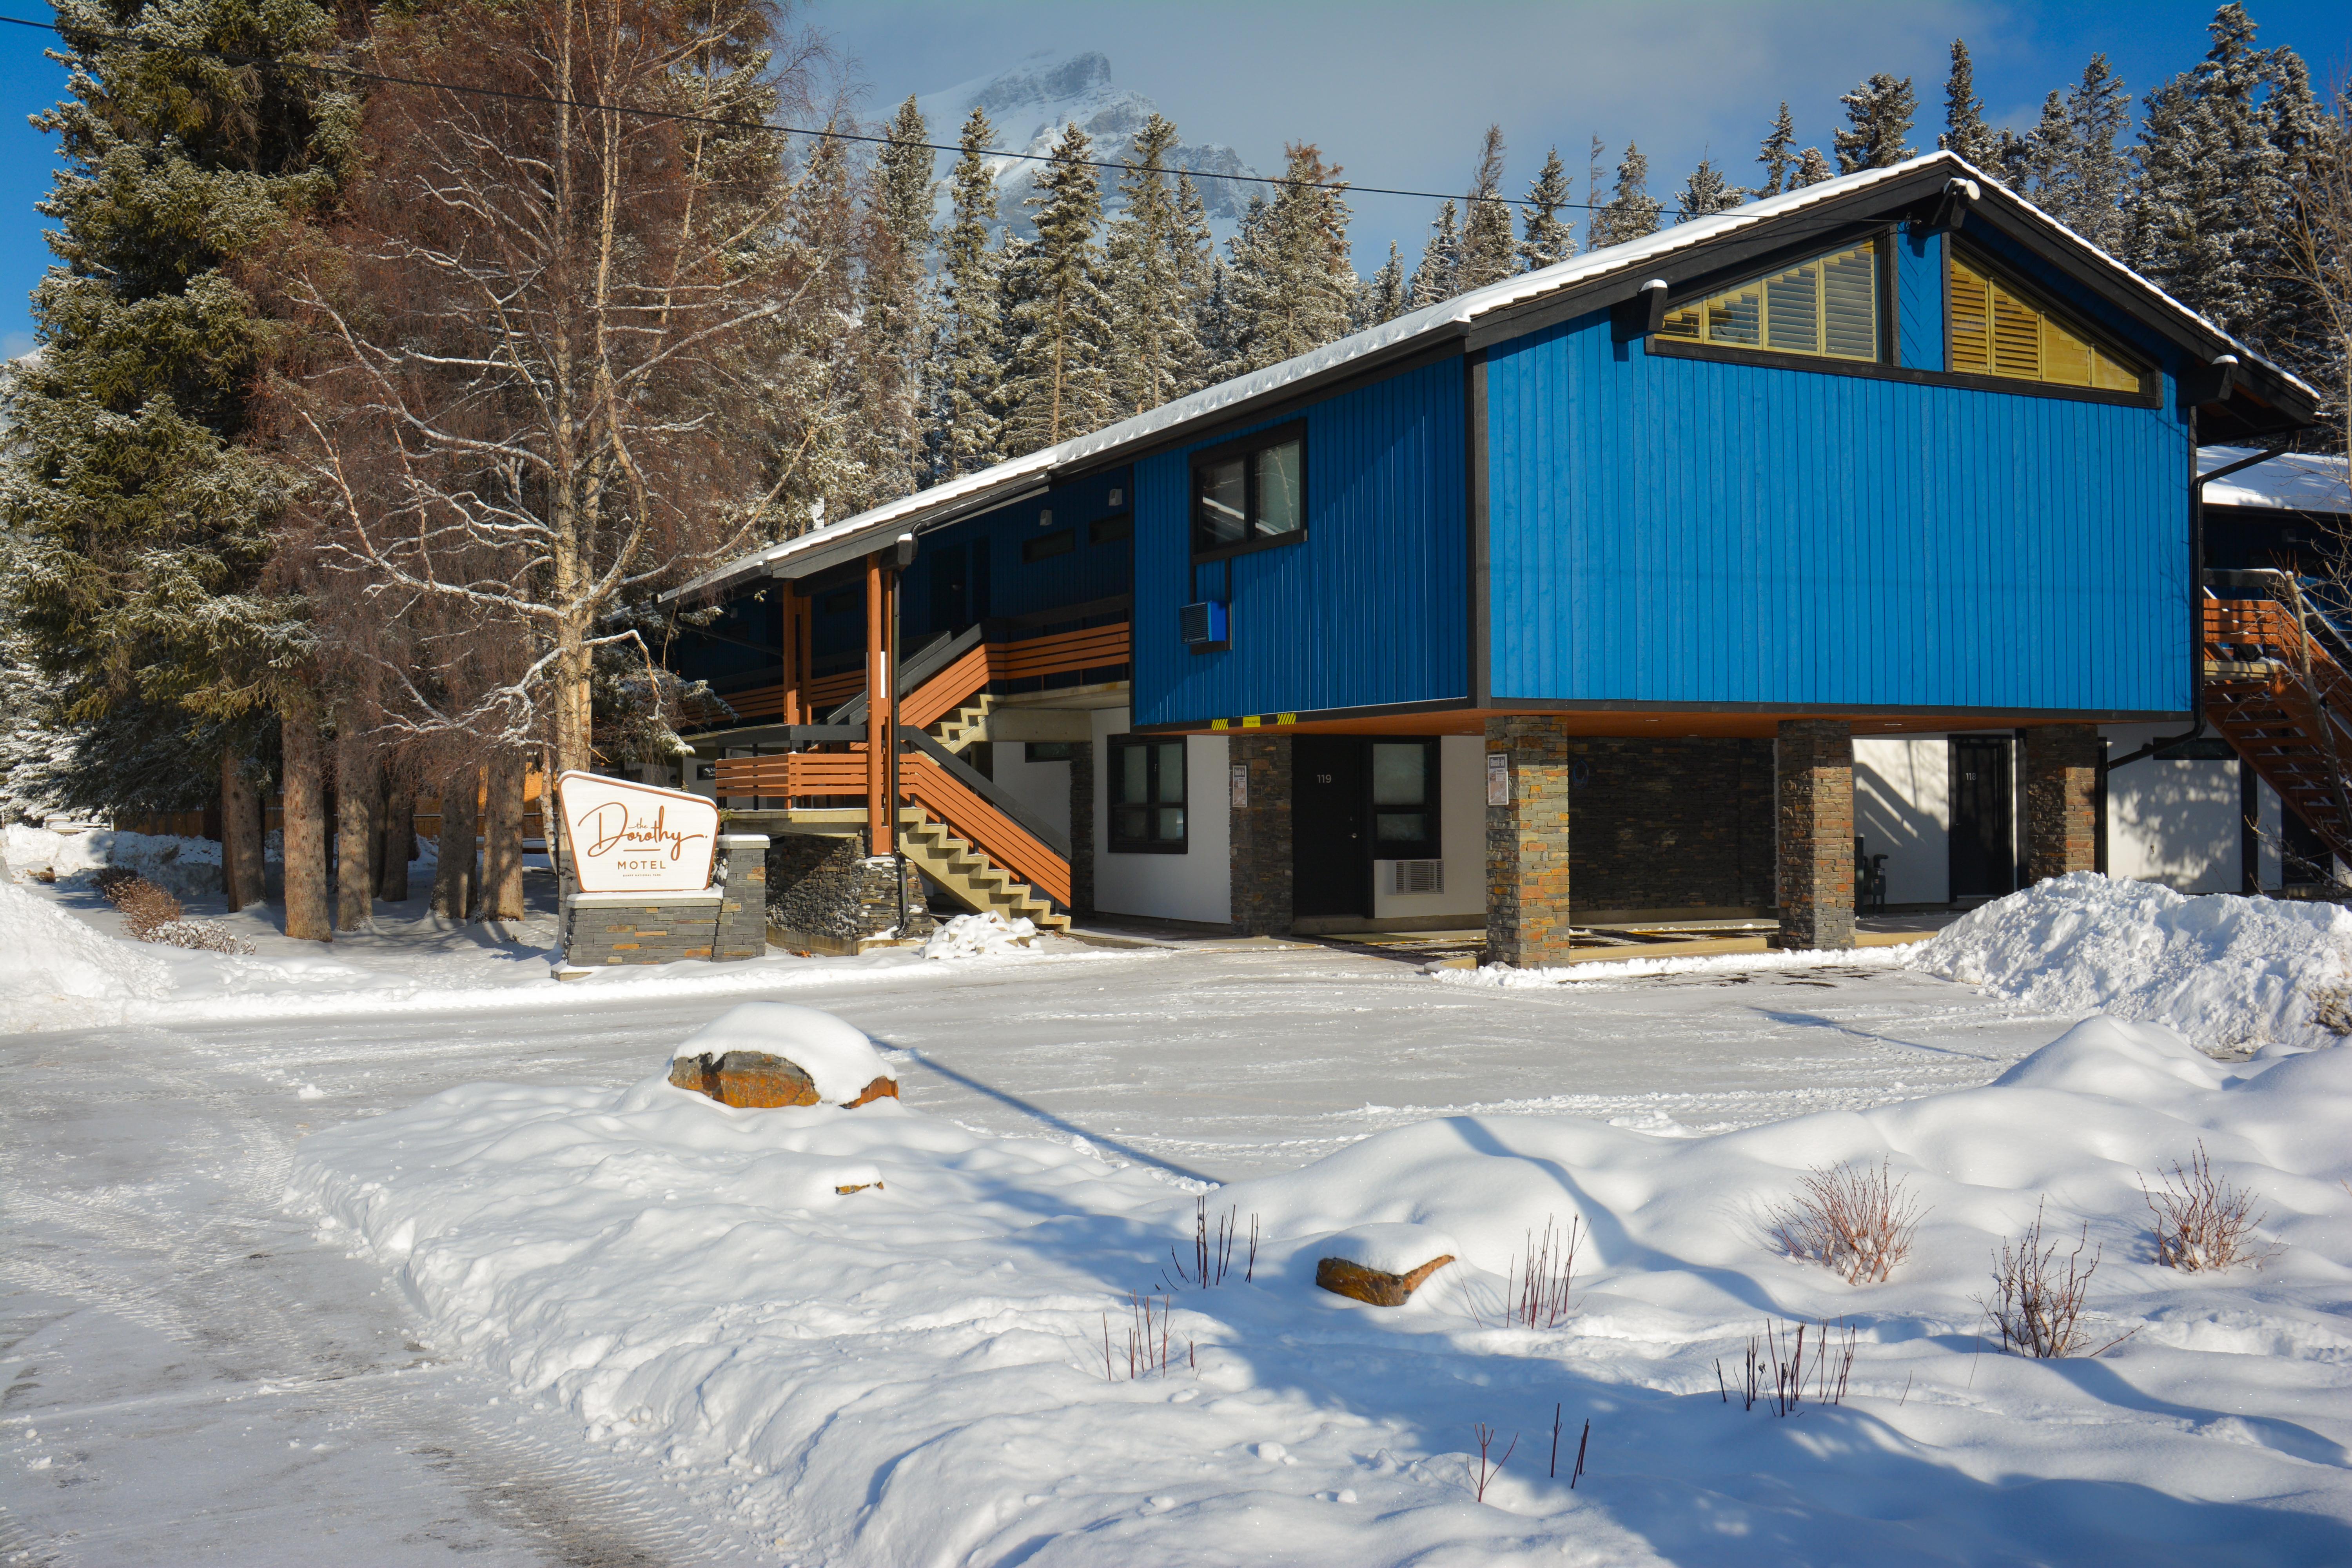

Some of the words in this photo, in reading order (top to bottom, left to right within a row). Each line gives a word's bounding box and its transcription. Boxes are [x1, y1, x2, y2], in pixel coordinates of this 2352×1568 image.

[1317, 774, 1332, 783] 119
[628, 817, 648, 829] the
[578, 802, 704, 861] Dorothy
[618, 860, 666, 870] MOTEL
